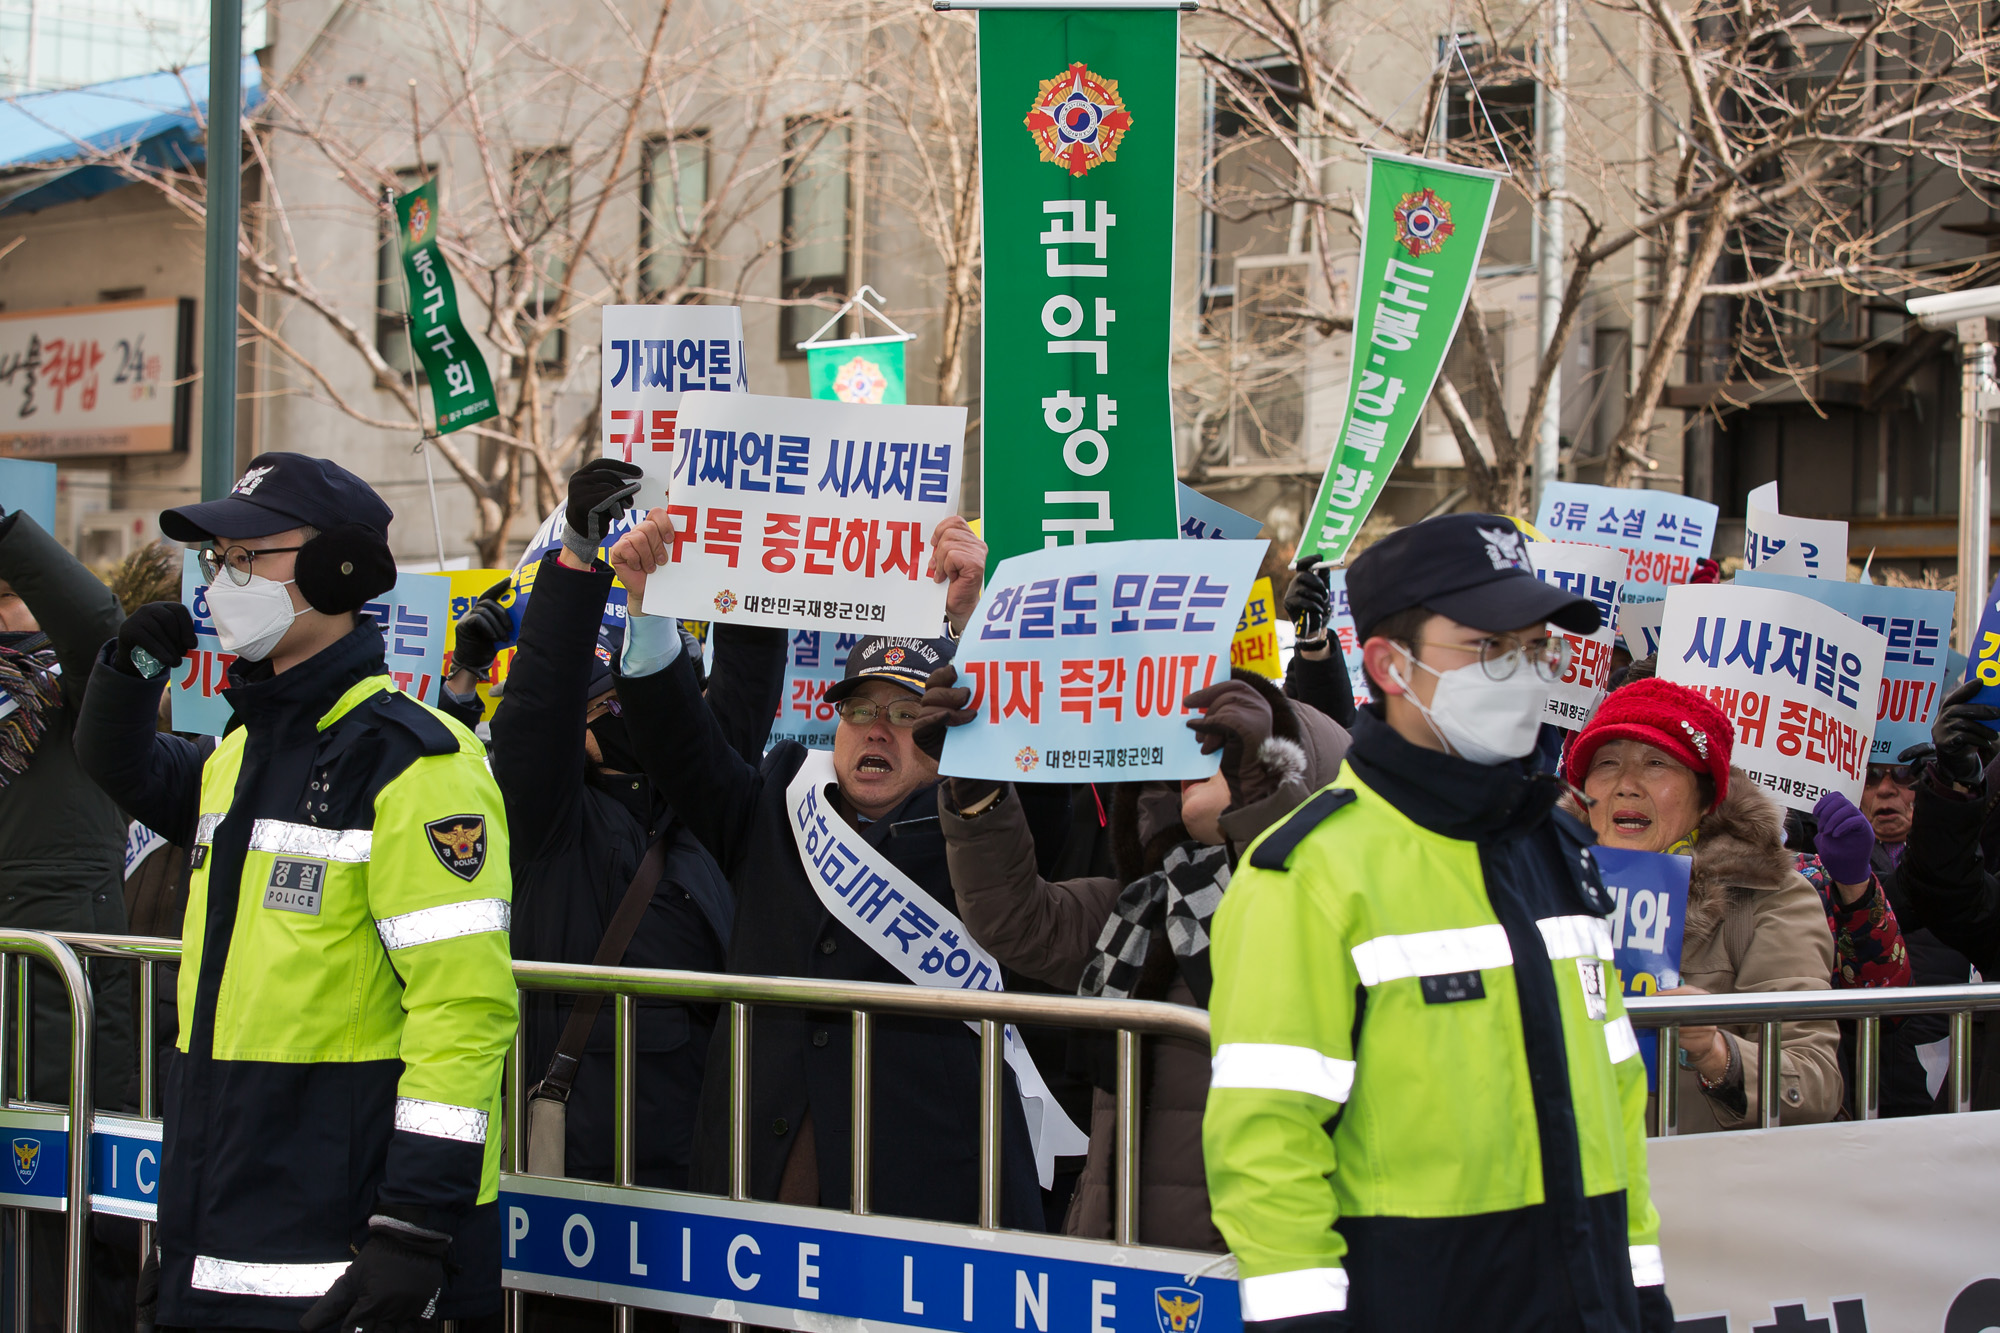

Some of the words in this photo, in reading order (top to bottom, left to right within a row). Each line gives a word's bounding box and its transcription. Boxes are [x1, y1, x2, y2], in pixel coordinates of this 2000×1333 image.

[610, 339, 731, 392] 가짜언론
[610, 410, 678, 463] 구독
[674, 428, 811, 495] 가짜언론
[817, 439, 952, 504] 시사저널
[667, 504, 743, 568] 구독
[1550, 502, 1589, 531] 3류
[1597, 506, 1646, 539] 소설
[1654, 512, 1703, 548] 쓰는
[744, 595, 886, 622] 대한민국재향군인회
[980, 574, 1098, 640] 한글도
[1111, 574, 1230, 634] 모르는
[861, 637, 885, 660] KOREAN
[887, 636, 923, 652] VETERANS
[1683, 616, 1862, 710] 시사저널은
[964, 660, 1044, 725] 기자
[1060, 657, 1127, 725] 즉각
[1135, 654, 1218, 718] OUT!
[1876, 678, 1937, 724] OUT!
[1046, 746, 1164, 769] 대한민국재향군인회
[1776, 699, 1868, 781] 중단하라!
[453, 857, 479, 867] POLICE
[268, 890, 315, 908] POLICE
[508, 1206, 820, 1300] POLICE
[904, 1254, 1117, 1333] LINE
